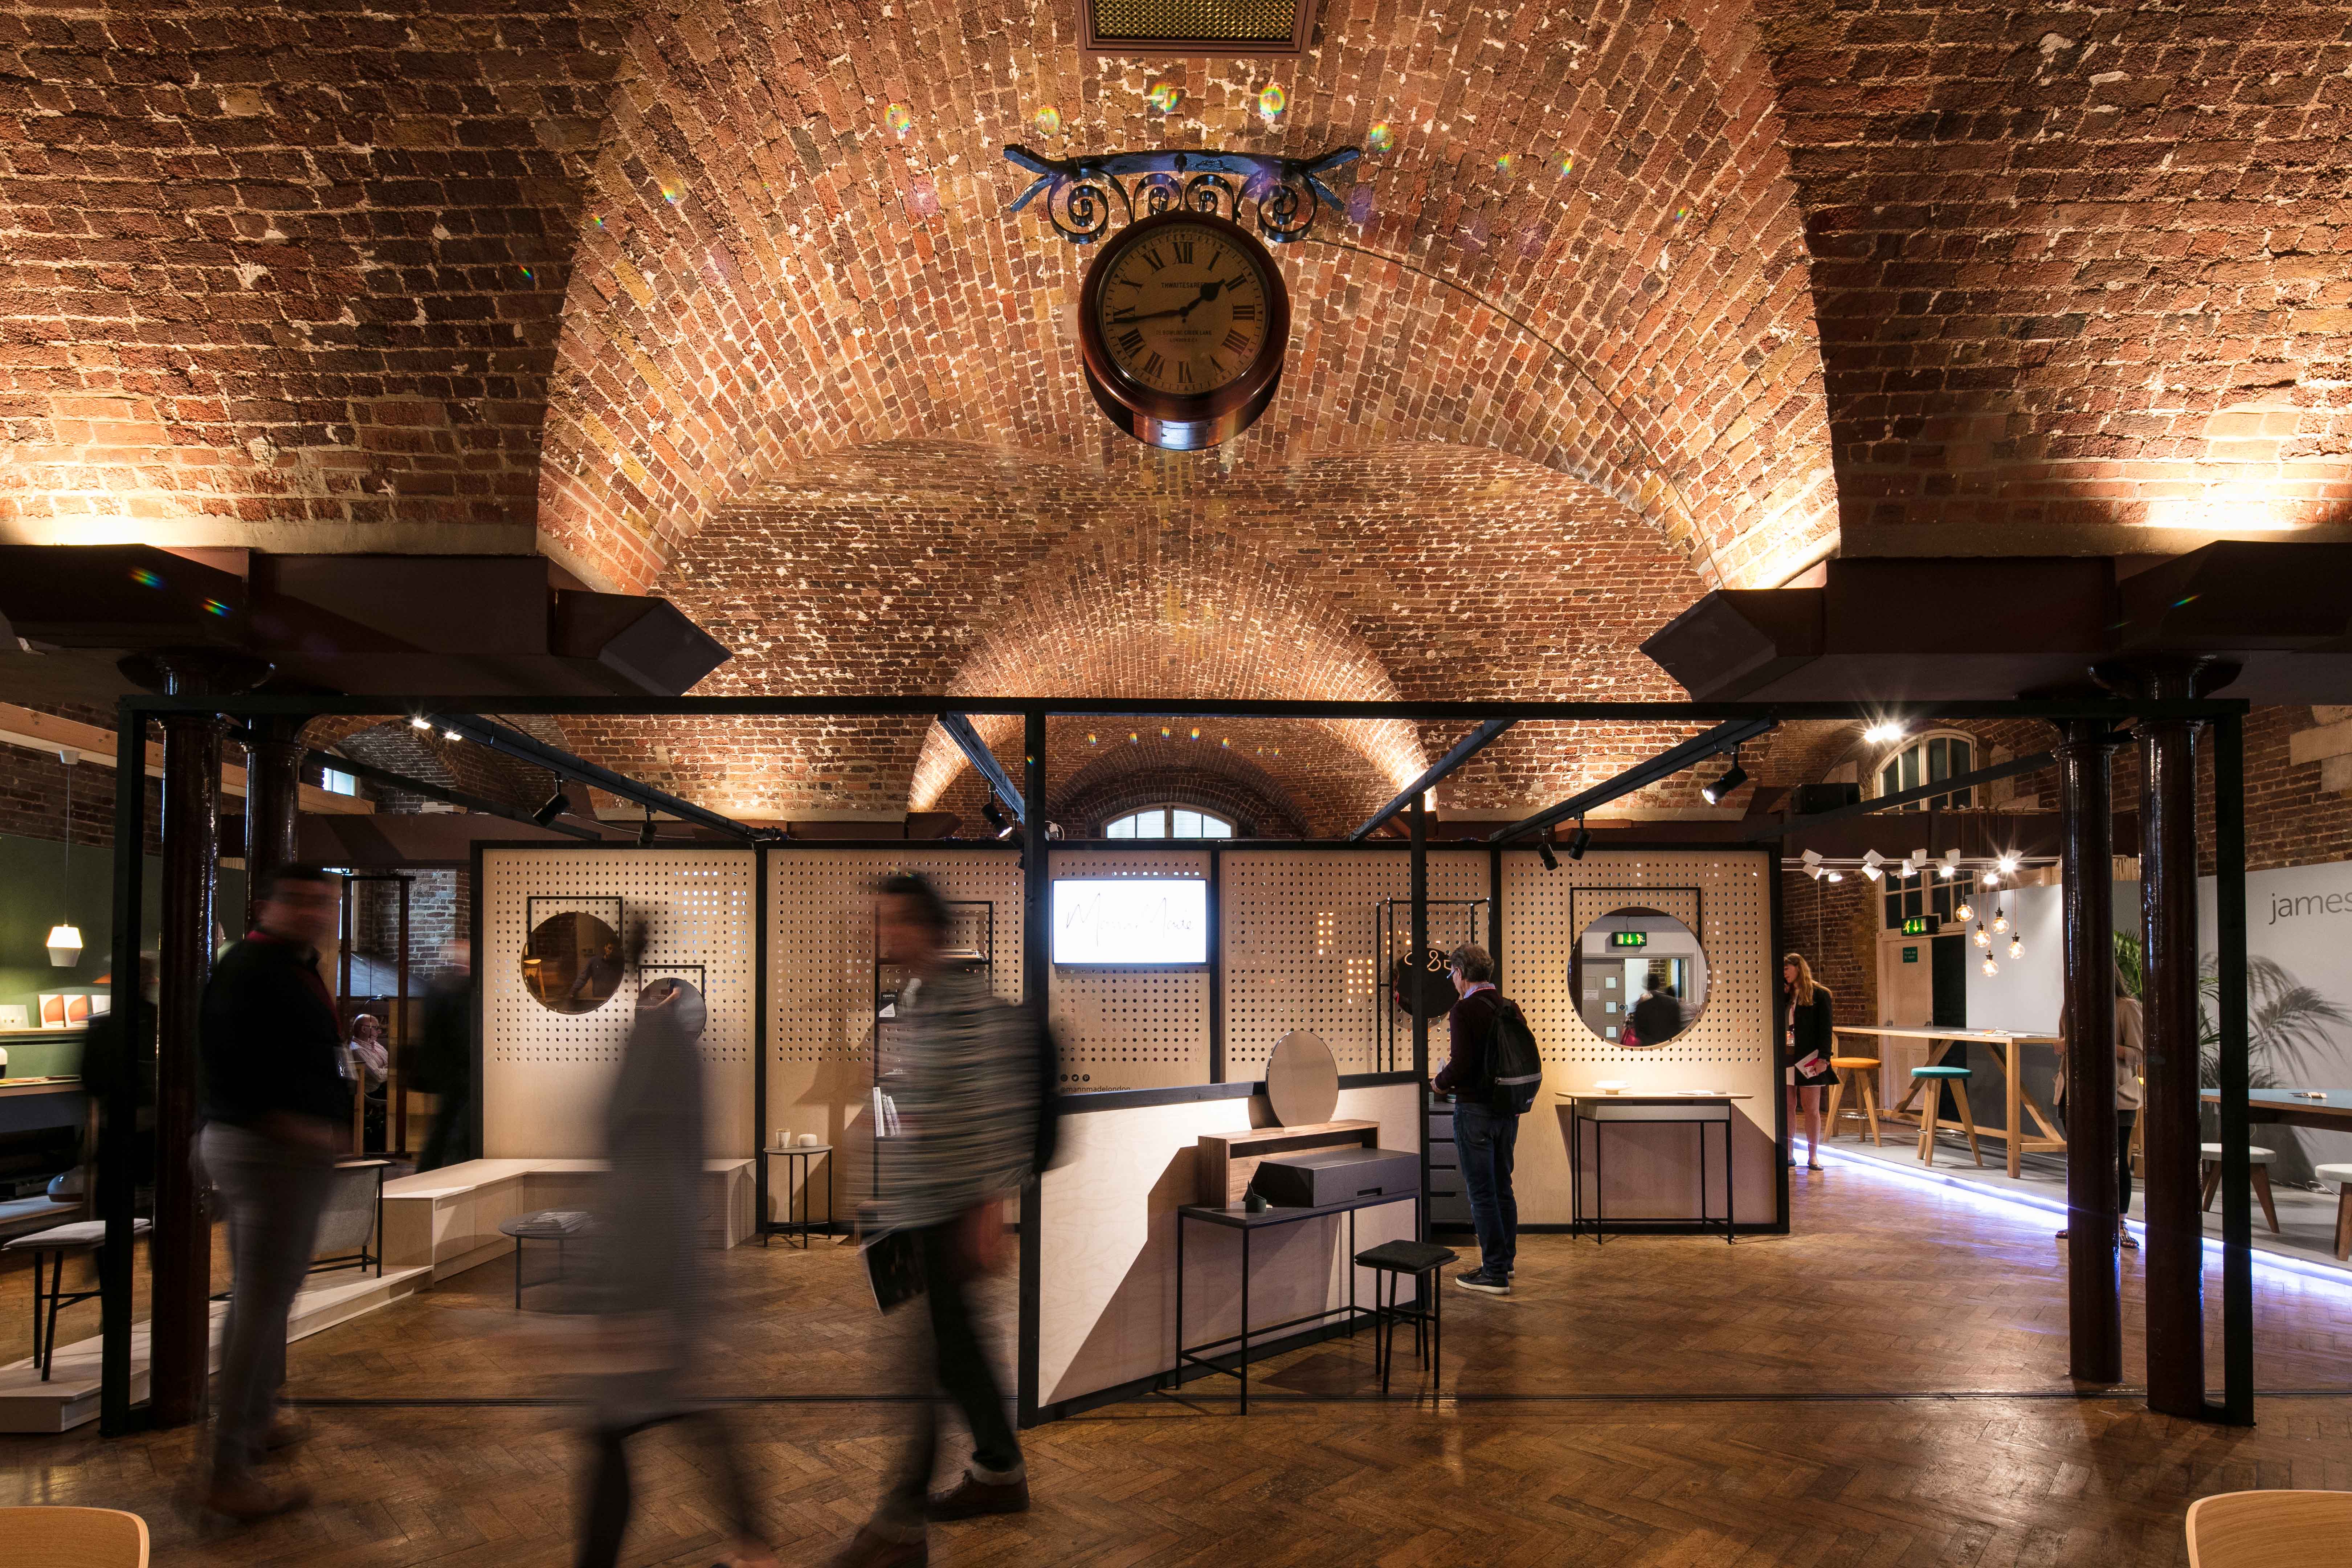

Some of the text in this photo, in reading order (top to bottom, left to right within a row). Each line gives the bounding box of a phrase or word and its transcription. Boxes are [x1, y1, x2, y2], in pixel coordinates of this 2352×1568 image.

[1141, 248, 1167, 275] XI
[1173, 241, 1195, 264] XII
[1205, 250, 1222, 272] I
[1119, 274, 1144, 295] X
[1225, 272, 1248, 294] II
[1232, 302, 1256, 322] III
[1117, 327, 1146, 359] VIII
[1142, 350, 1165, 379] VII
[1177, 360, 1193, 384] VI
[1209, 354, 1226, 375] V
[2269, 892, 2352, 925] james
